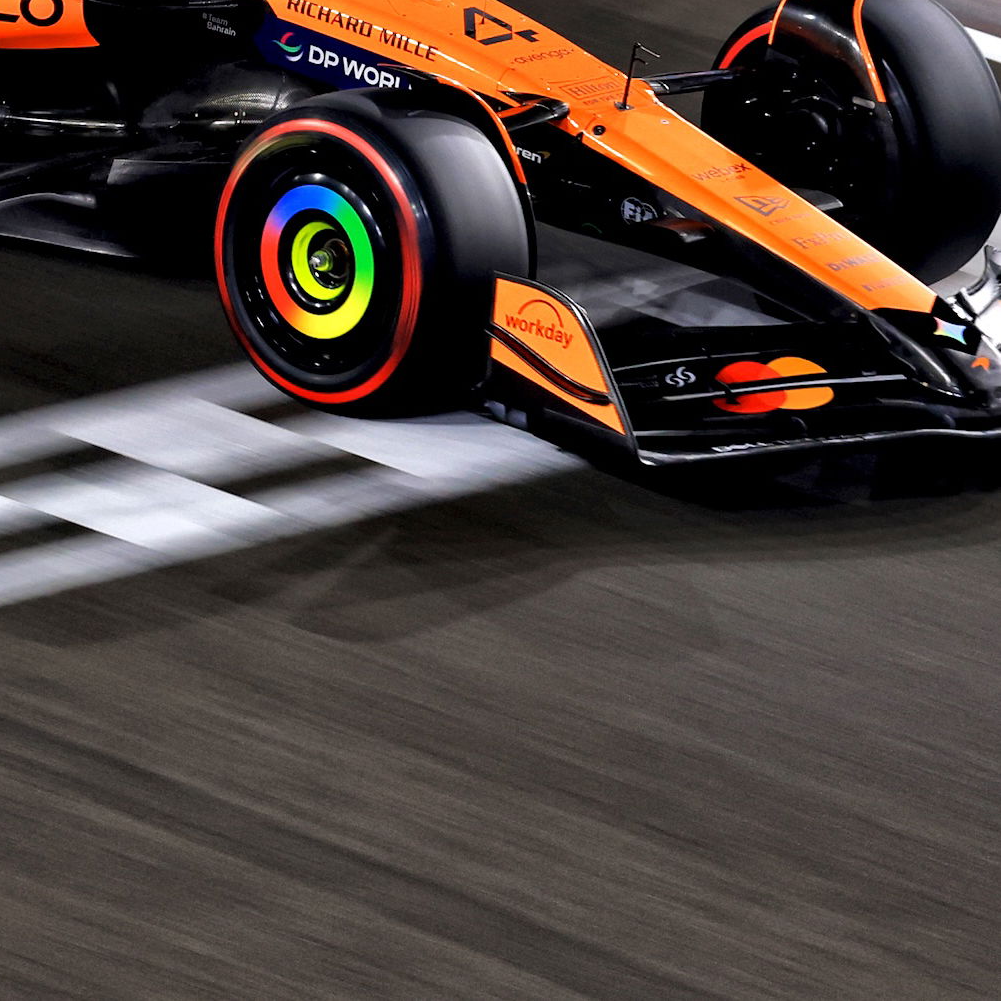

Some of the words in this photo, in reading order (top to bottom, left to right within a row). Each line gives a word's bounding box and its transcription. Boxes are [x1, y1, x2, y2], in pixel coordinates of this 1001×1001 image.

[206, 21, 237, 37] Bahrain
[379, 27, 439, 62] MILLE
[308, 45, 339, 68] DP
[343, 56, 413, 91] WOR
[512, 145, 542, 164] ren
[692, 163, 751, 181] webex
[505, 314, 573, 349] workday
